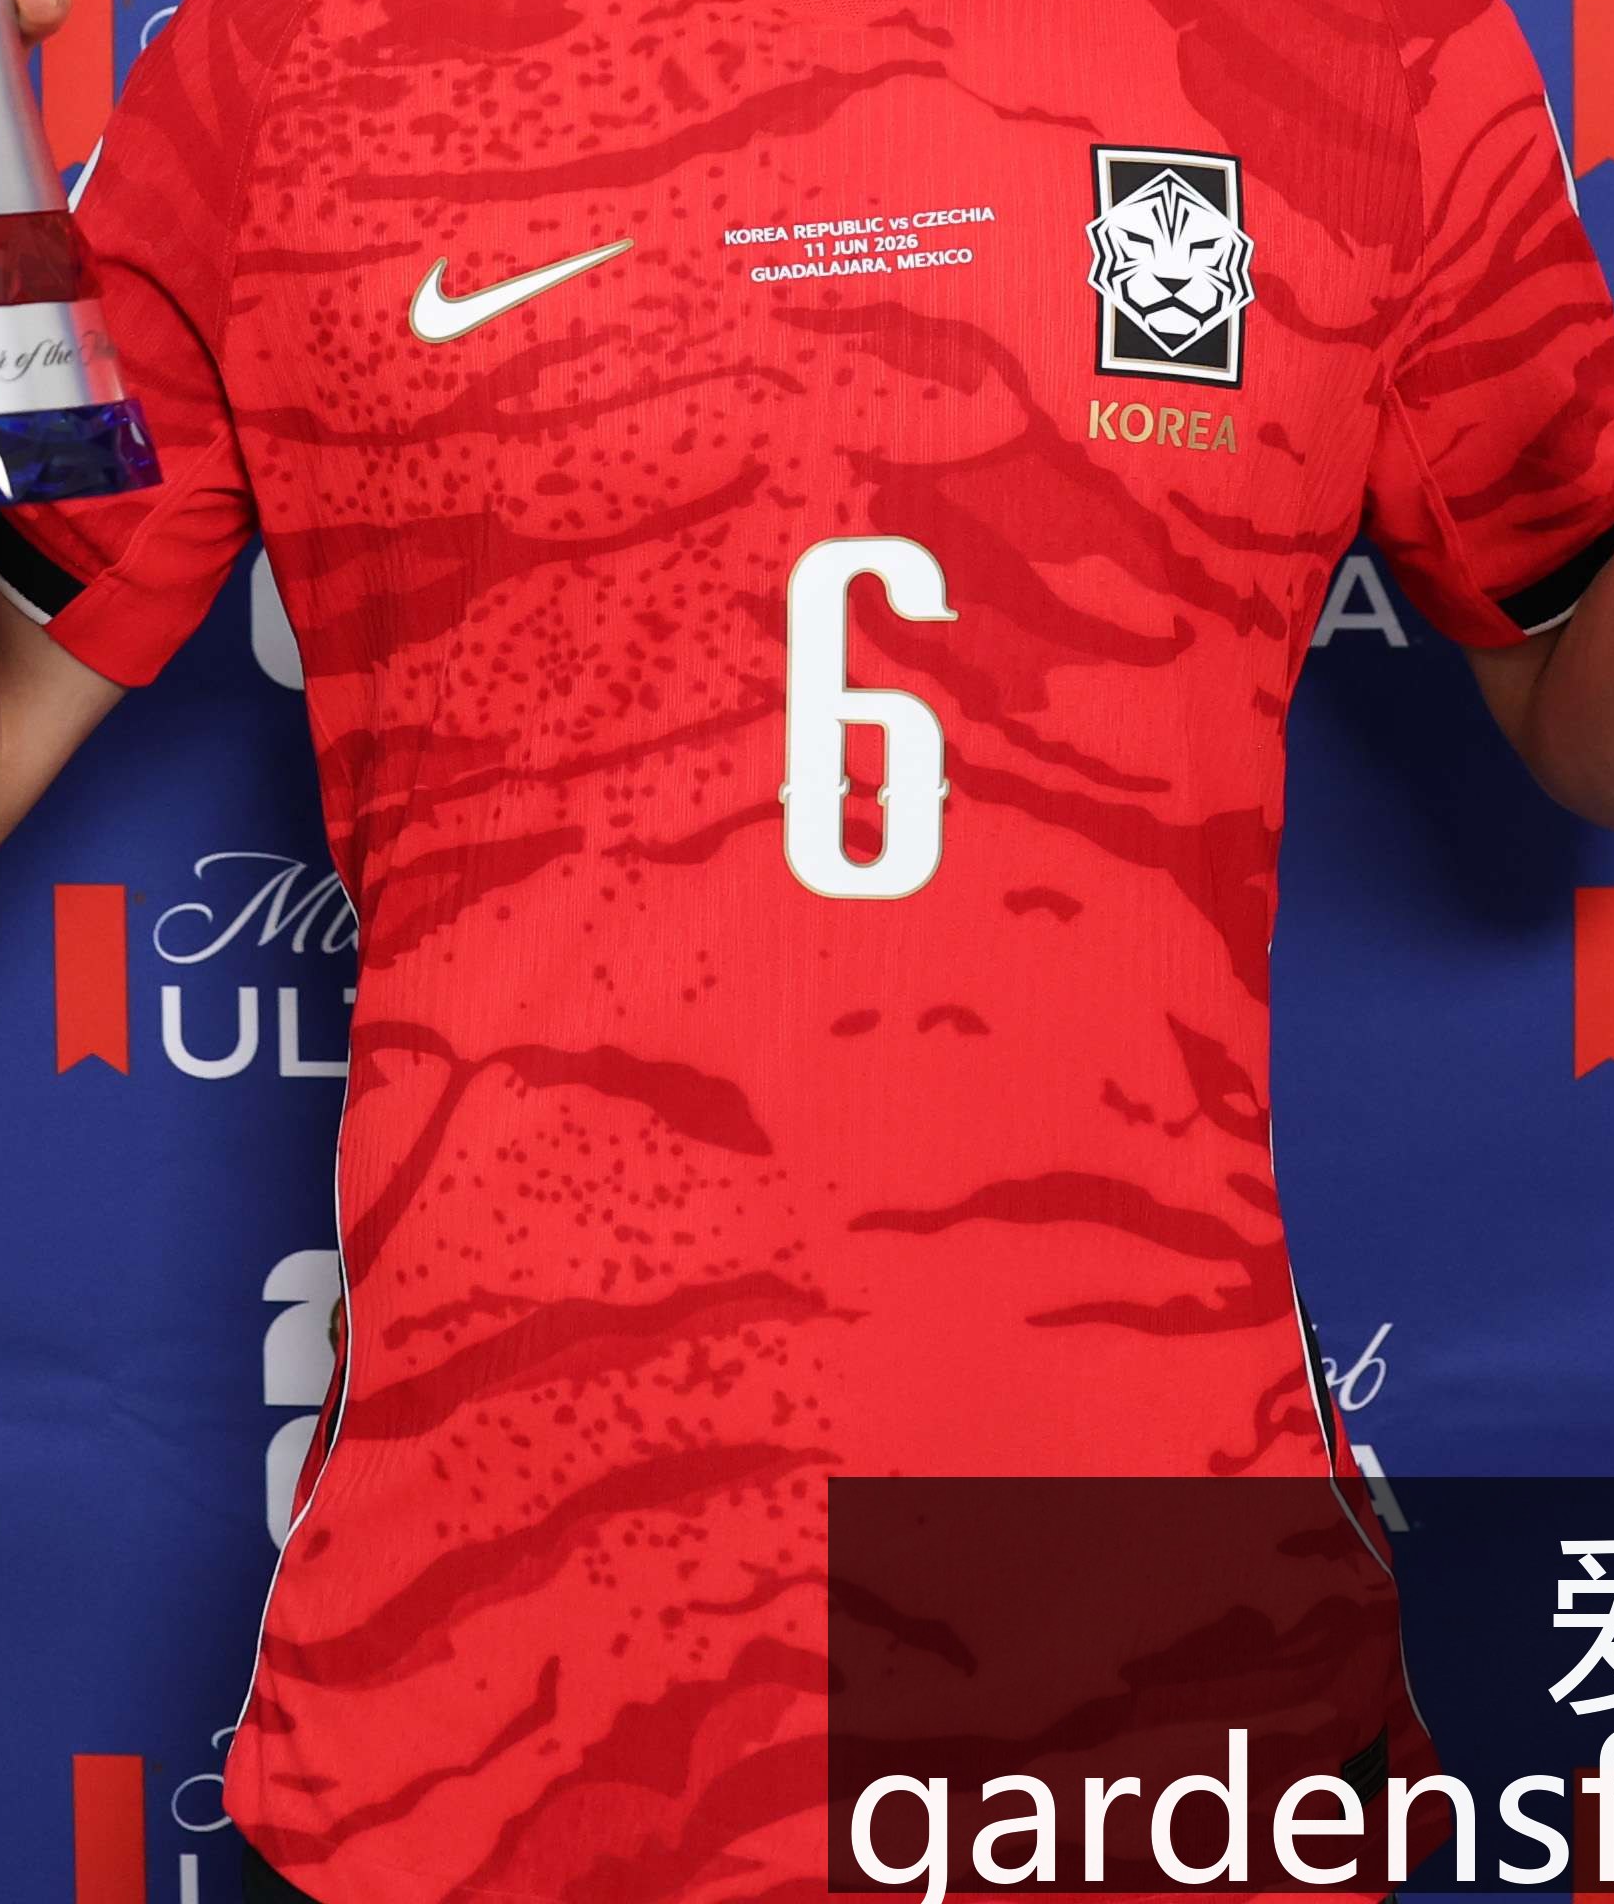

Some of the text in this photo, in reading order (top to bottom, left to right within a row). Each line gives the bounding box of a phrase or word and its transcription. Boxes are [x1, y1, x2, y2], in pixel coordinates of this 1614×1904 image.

[724, 207, 995, 245] KOREA REPUBLIC vs CZECHIA
[750, 248, 973, 282] GUADALAJARA, MEXICO
[804, 234, 919, 258] 11 JUN 2026
[1088, 399, 1238, 454] KOREA
[777, 535, 959, 900] 6
